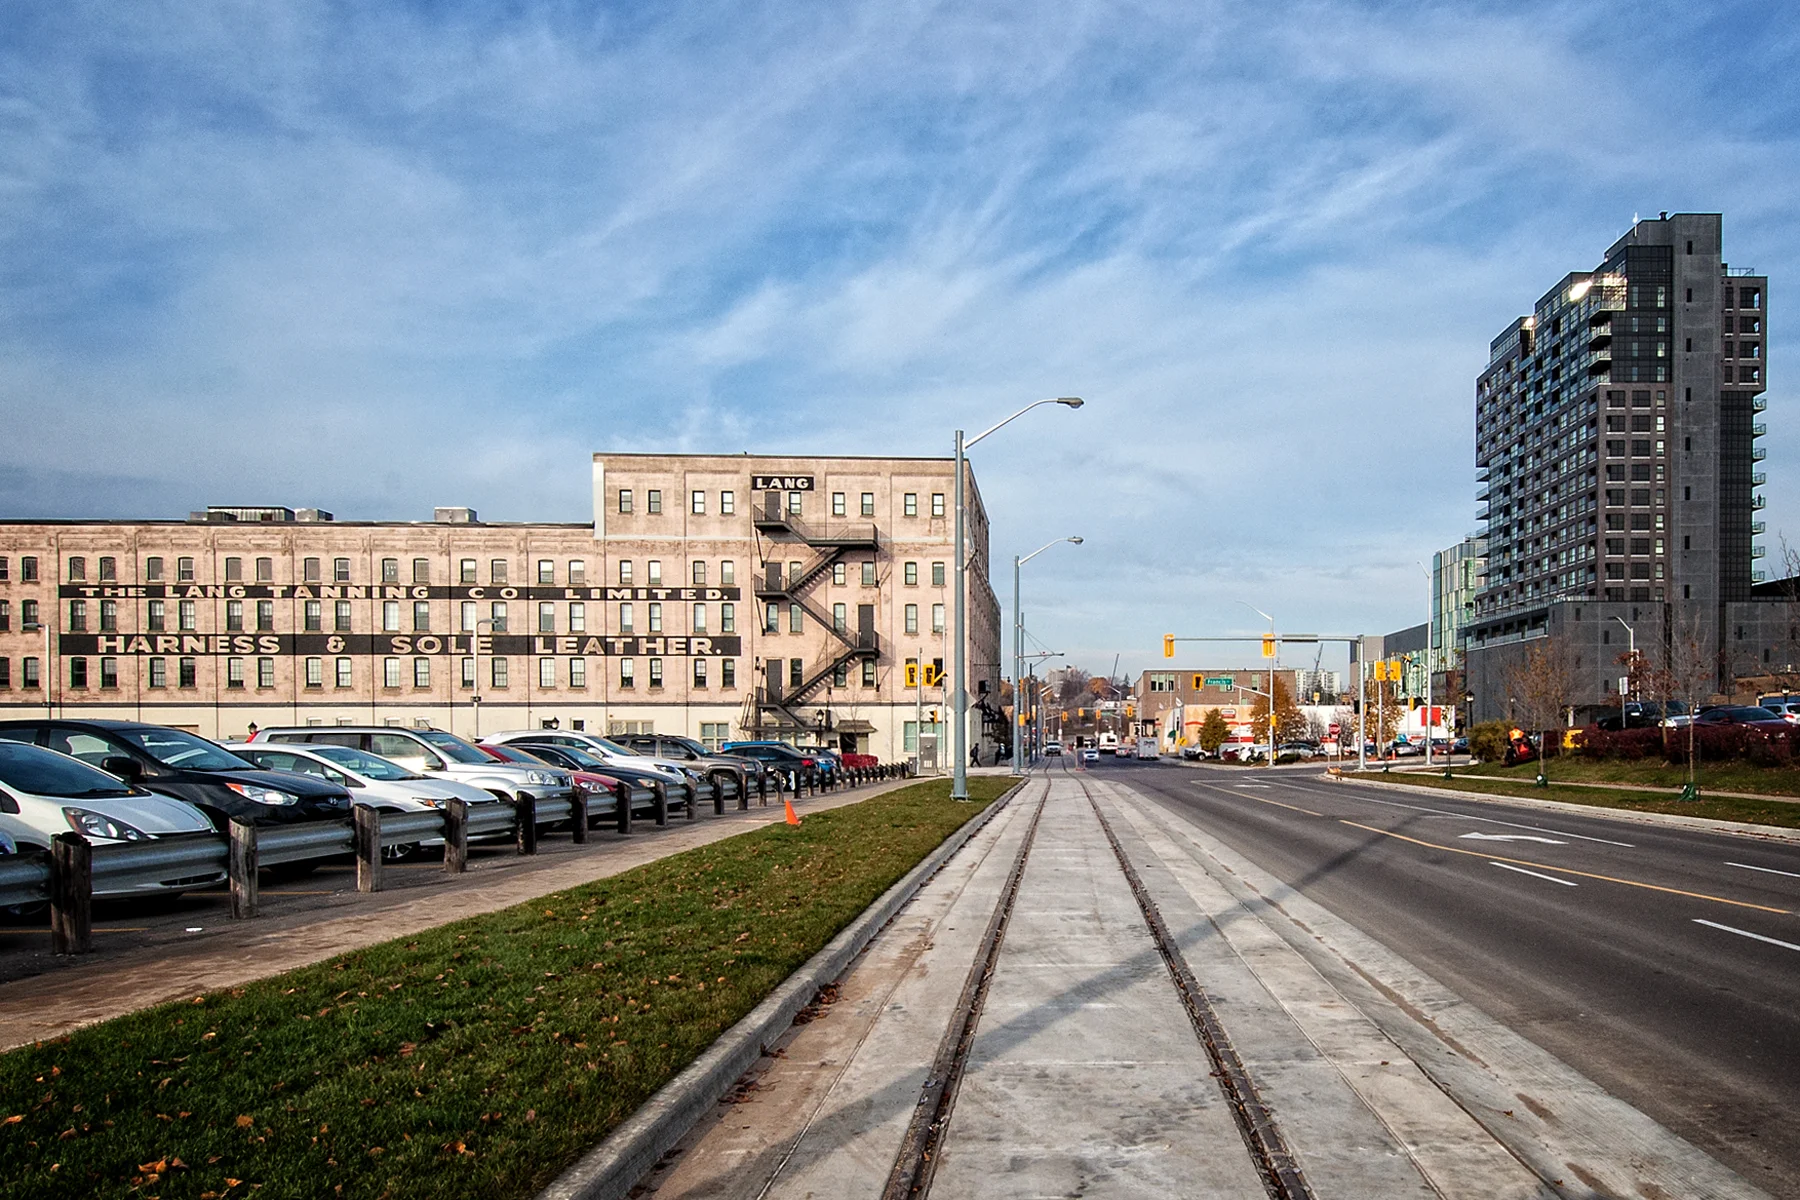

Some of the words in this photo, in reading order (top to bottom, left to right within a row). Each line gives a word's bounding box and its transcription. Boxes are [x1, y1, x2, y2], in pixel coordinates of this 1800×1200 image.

[756, 477, 809, 489] LANG
[79, 587, 147, 597] THE
[164, 586, 246, 598] LANG
[267, 586, 429, 599] TANNING
[468, 587, 534, 599] CO.
[564, 588, 729, 600] LIMITED.
[97, 635, 281, 654] HARNESS
[326, 635, 346, 653] &
[390, 635, 493, 654] SOLE
[535, 637, 722, 655] LEATHER.
